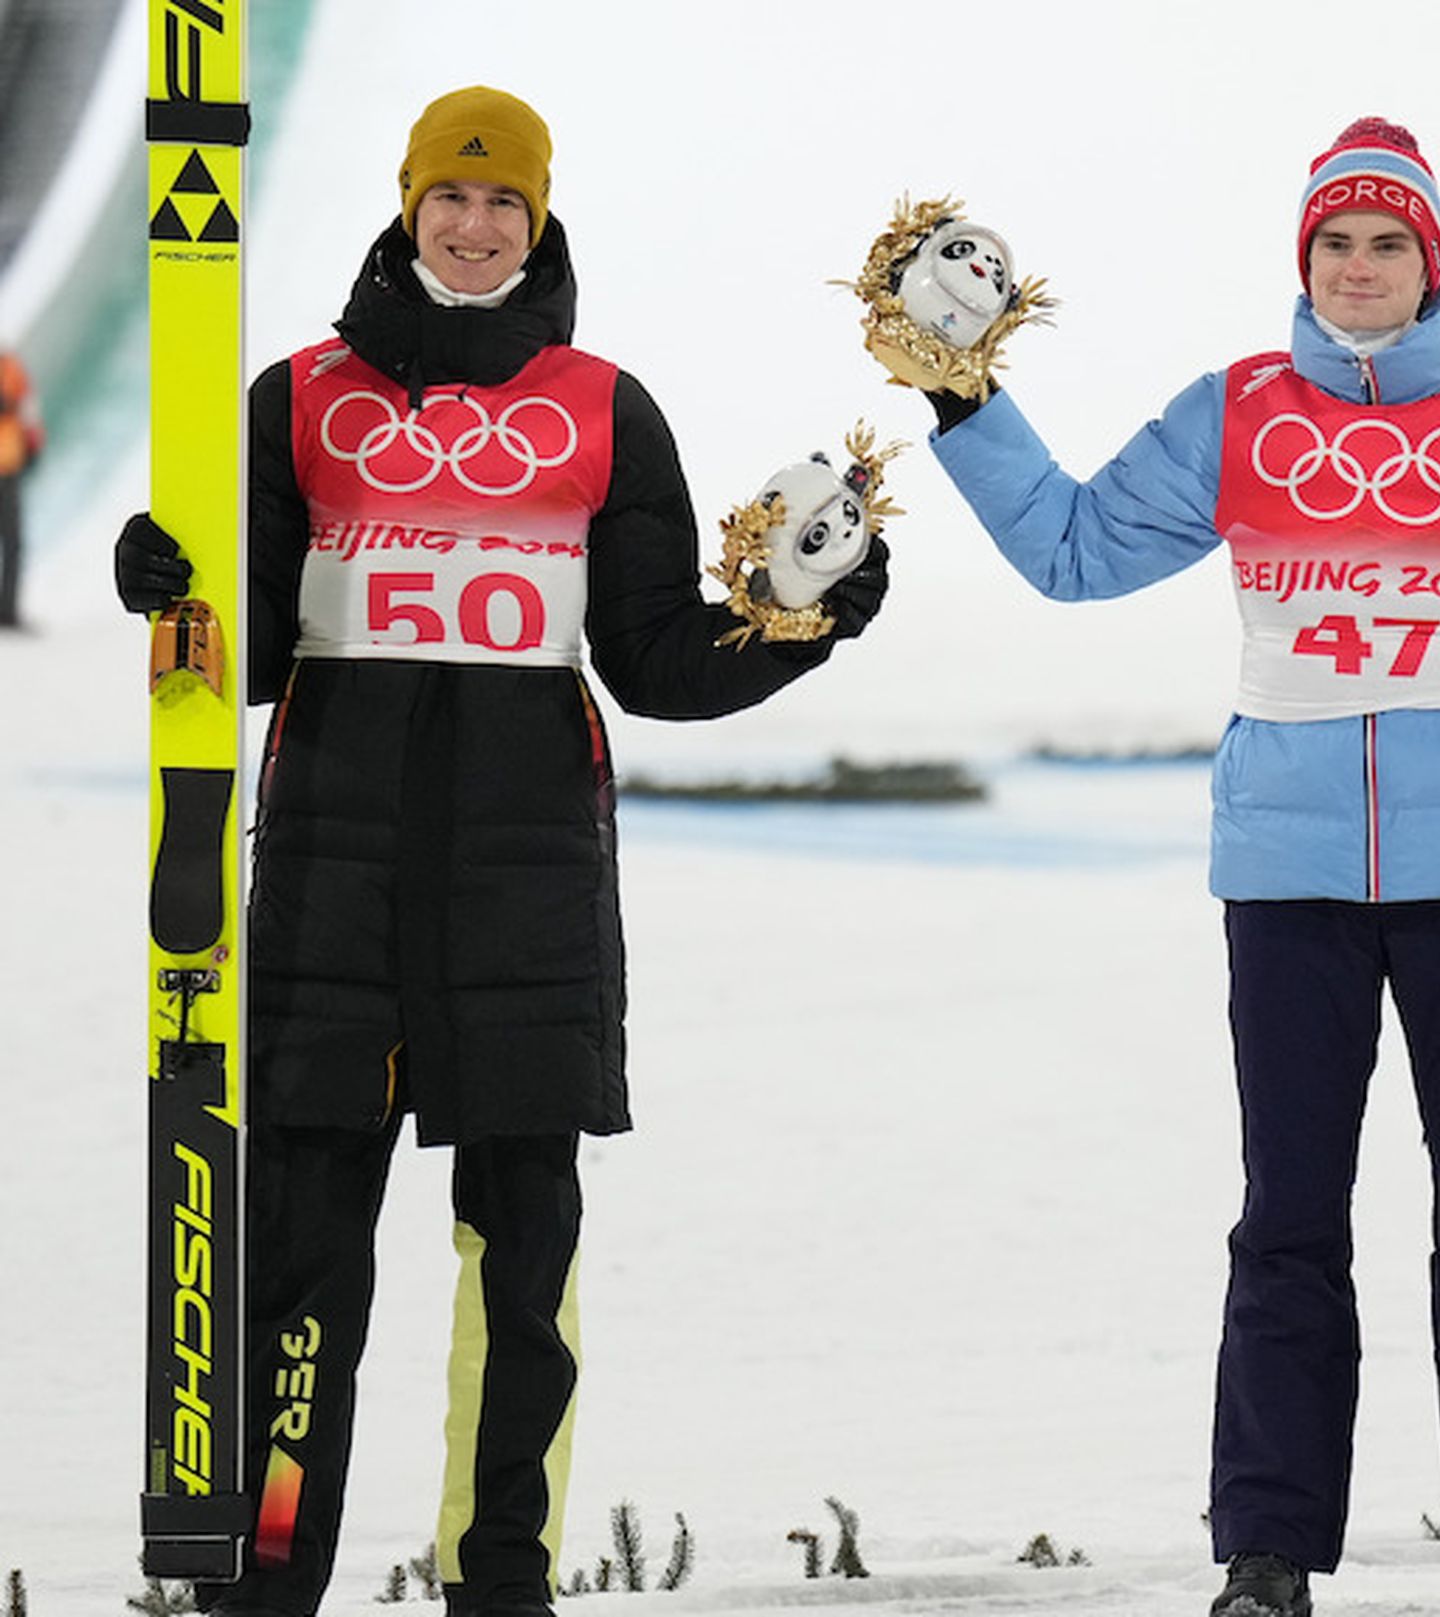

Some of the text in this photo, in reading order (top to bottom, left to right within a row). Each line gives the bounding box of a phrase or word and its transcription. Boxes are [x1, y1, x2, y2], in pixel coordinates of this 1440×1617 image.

[1310, 179, 1425, 223] NORGE
[153, 251, 237, 263] FISCHER
[1236, 560, 1382, 603] BEIJING
[367, 572, 546, 652] 50
[1292, 614, 1440, 678] 47
[269, 1314, 322, 1441] GER
